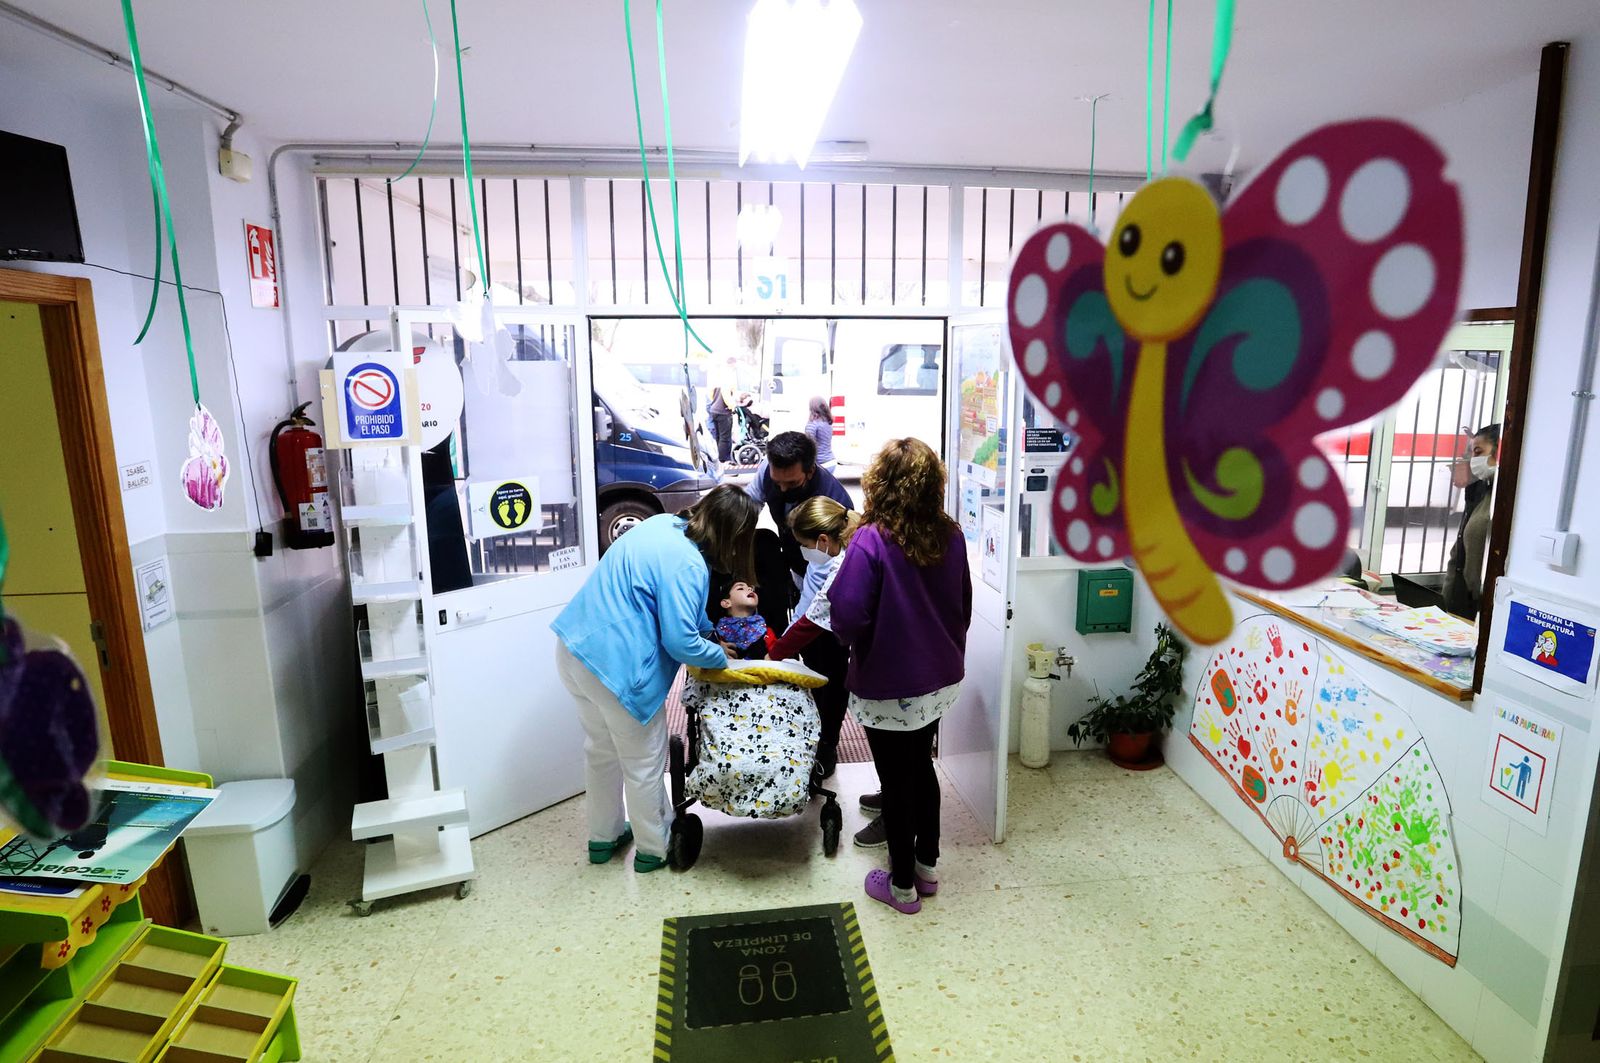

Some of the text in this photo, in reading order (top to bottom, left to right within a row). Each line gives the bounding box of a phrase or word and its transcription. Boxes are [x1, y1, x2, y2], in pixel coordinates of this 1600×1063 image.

[355, 414, 395, 425] PROHIBIDO
[361, 425, 390, 435] EL PASO
[620, 432, 631, 441] 25
[1527, 608, 1574, 628] ME TOMAN LA
[1526, 614, 1575, 637] TEMPERATURA
[712, 932, 811, 949] DE LIMPIEZA
[741, 945, 786, 957] ZONA
